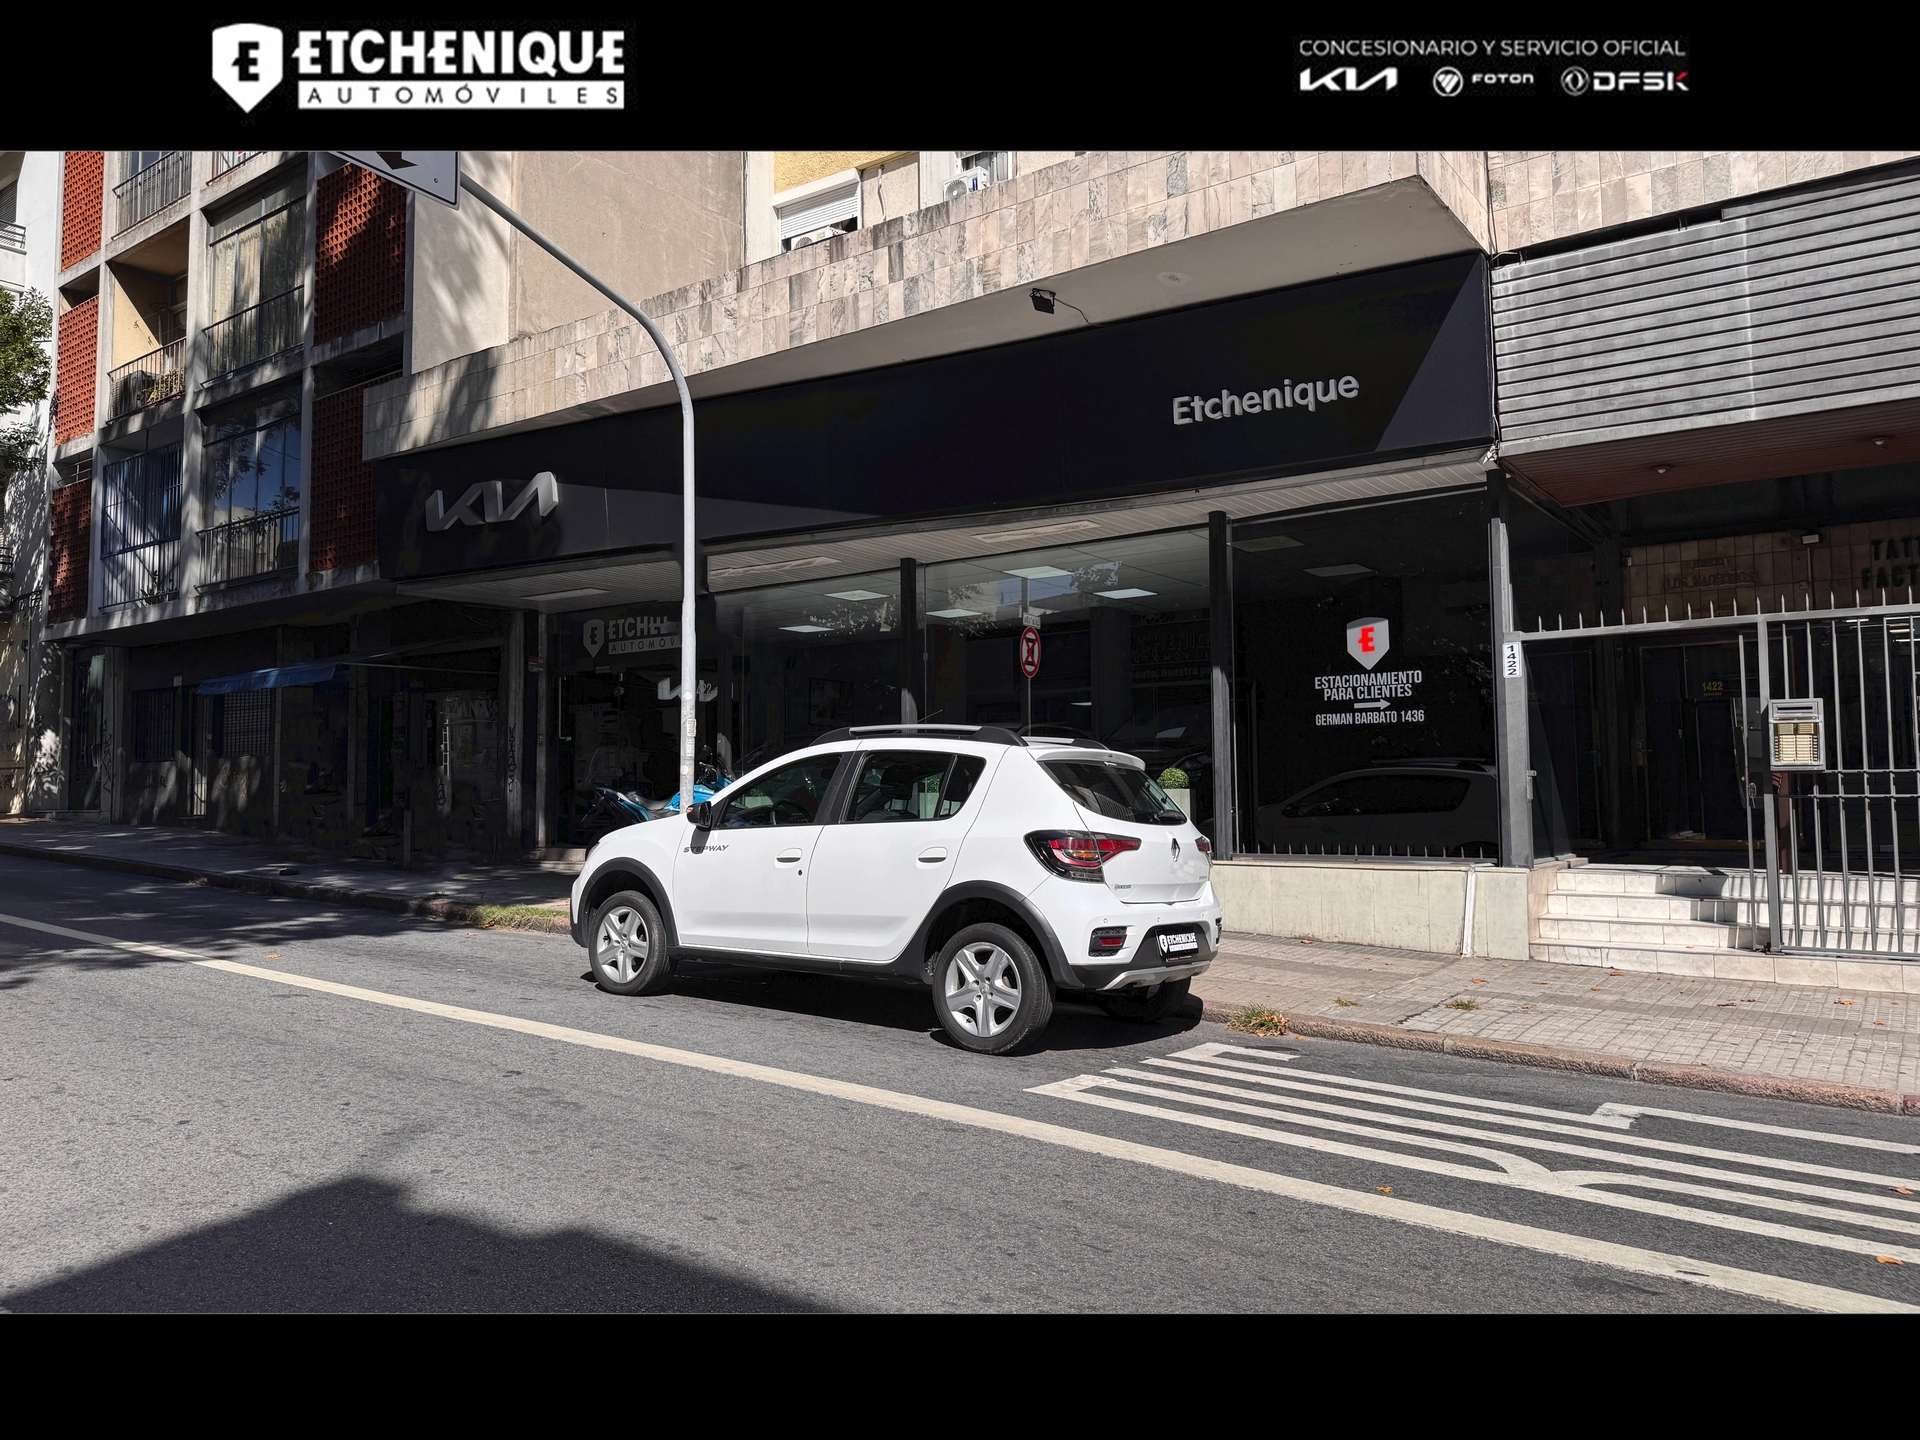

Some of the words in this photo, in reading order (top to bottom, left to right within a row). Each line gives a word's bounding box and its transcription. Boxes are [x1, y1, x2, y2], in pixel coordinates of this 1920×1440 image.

[1173, 375, 1360, 425] Etchenique
[426, 471, 559, 532] KIA
[1507, 645, 1517, 675] 1422
[1315, 670, 1422, 689] ESTACIONAMIENTO
[1702, 681, 1723, 692] 1422
[1324, 688, 1354, 701] PARA
[1357, 684, 1412, 699] CLIENTES
[1316, 713, 1353, 726] GERMAN
[1355, 711, 1397, 724] BARBATO
[1401, 710, 1425, 722] 1436
[683, 844, 729, 853] STEPWAY
